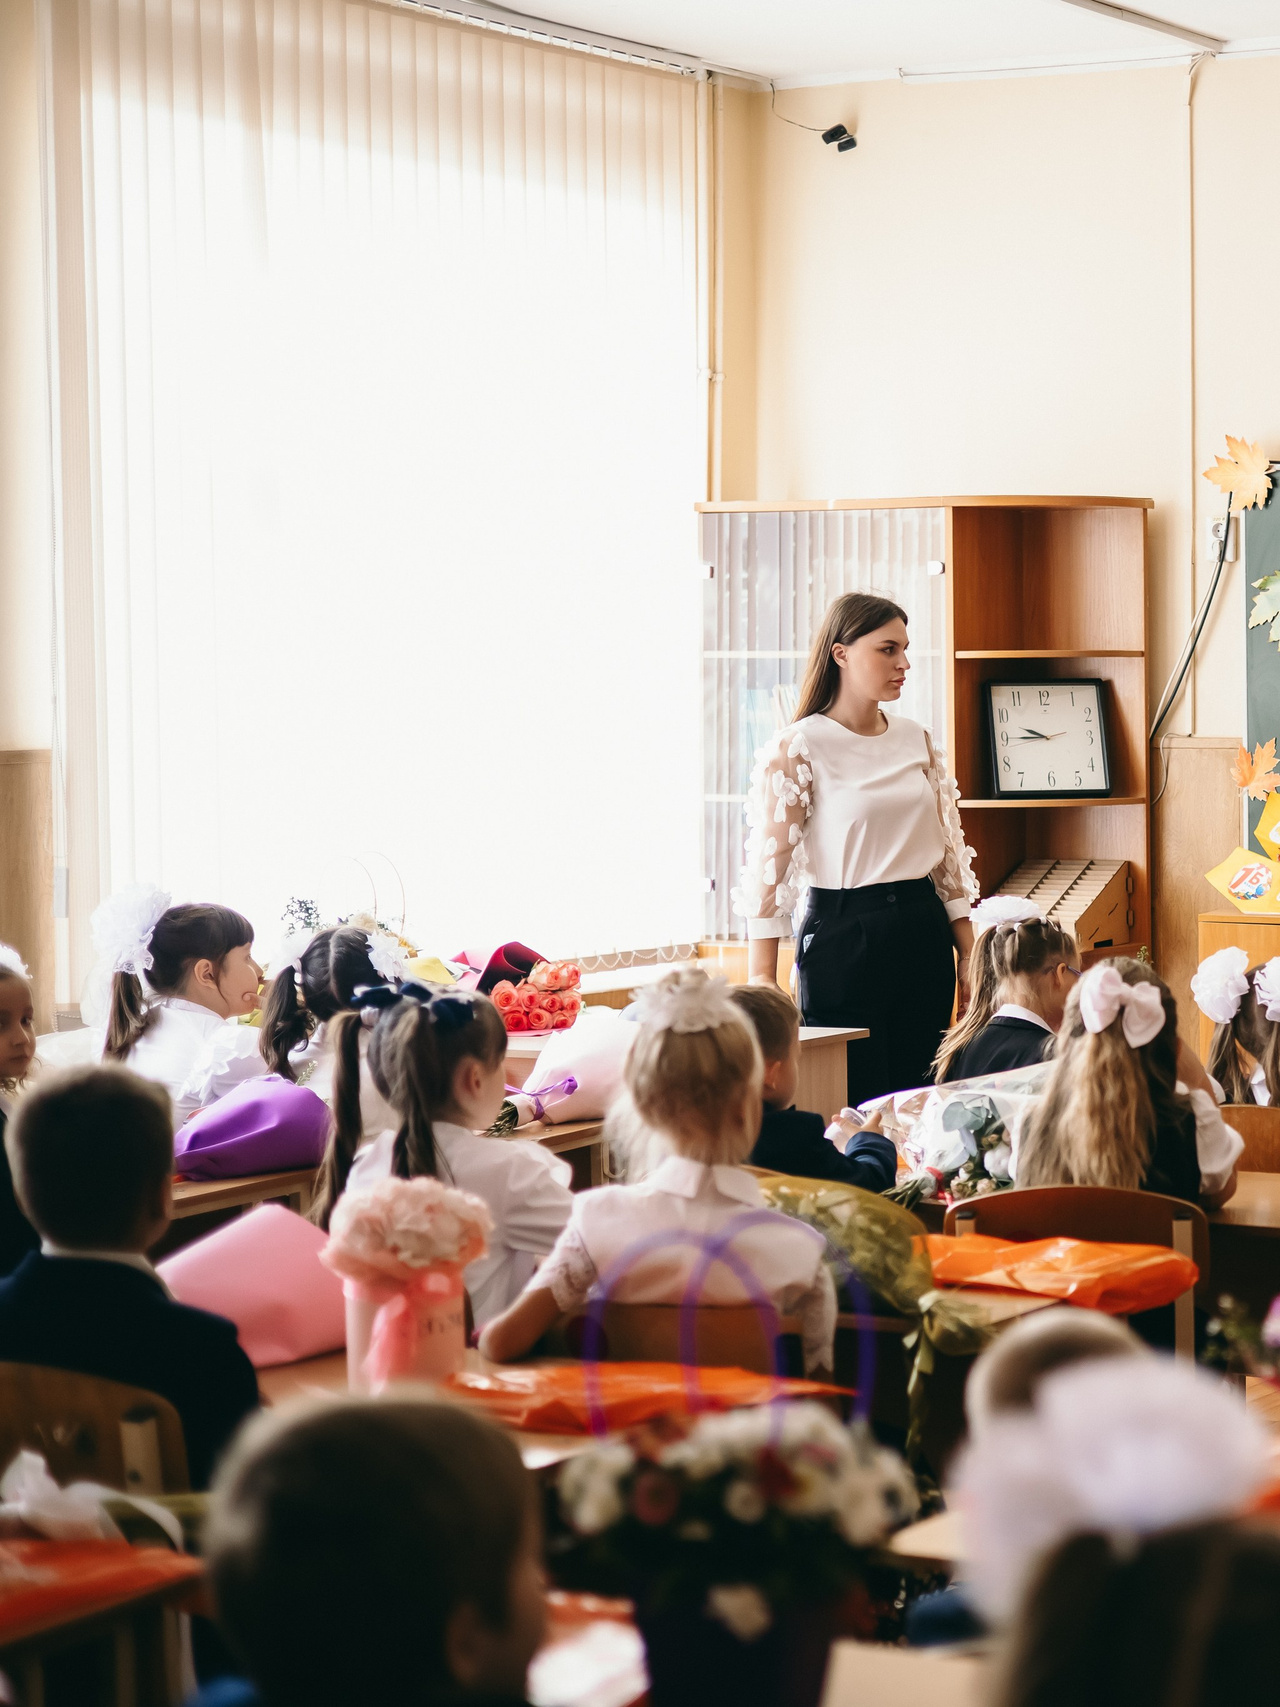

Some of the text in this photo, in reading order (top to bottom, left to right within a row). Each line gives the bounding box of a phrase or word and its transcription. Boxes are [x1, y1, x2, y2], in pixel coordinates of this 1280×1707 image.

[1011, 690, 1021, 707] 11
[1039, 690, 1050, 706] 12
[1070, 691, 1075, 707] 1
[998, 708, 1009, 723] 10
[1083, 707, 1092, 722] 2
[1000, 730, 1009, 747] 9
[1085, 730, 1094, 746] 3
[1002, 756, 1011, 772] 8
[1087, 757, 1095, 772] 4
[1017, 771, 1025, 787] 7
[1047, 771, 1056, 787] 6
[1074, 770, 1082, 787] 5
